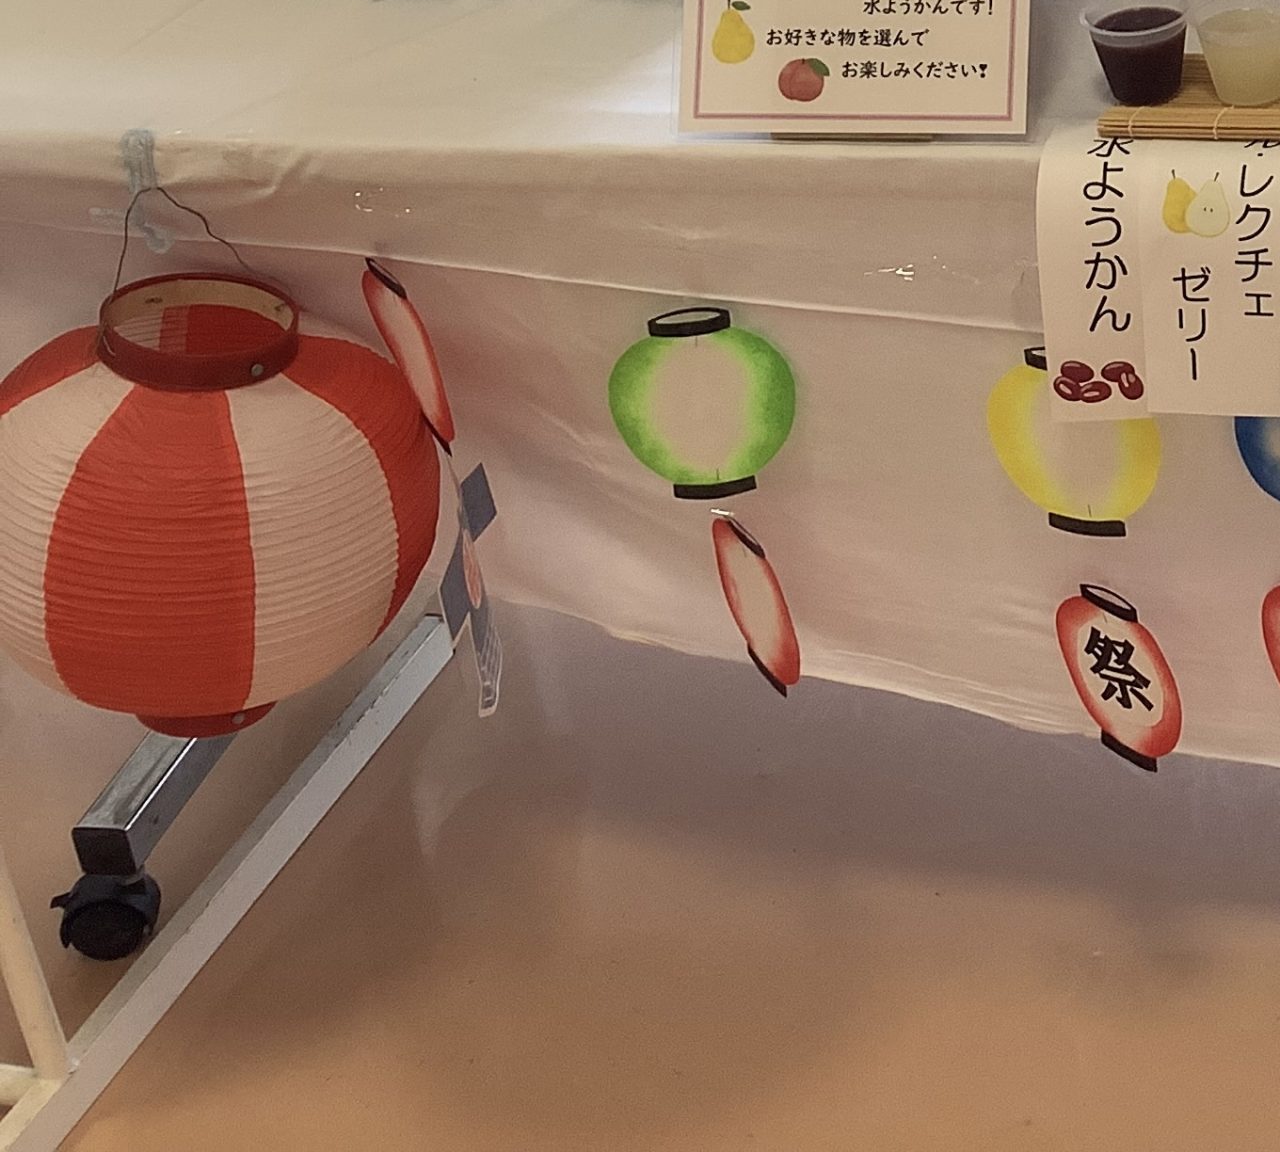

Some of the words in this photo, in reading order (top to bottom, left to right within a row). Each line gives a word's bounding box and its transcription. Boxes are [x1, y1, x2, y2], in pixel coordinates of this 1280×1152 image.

[766, 28, 929, 47] お好きな物を選んで
[1083, 137, 1134, 332] 水ようかん
[1172, 266, 1211, 381] ゼリー
[1084, 626, 1155, 711] 祭
